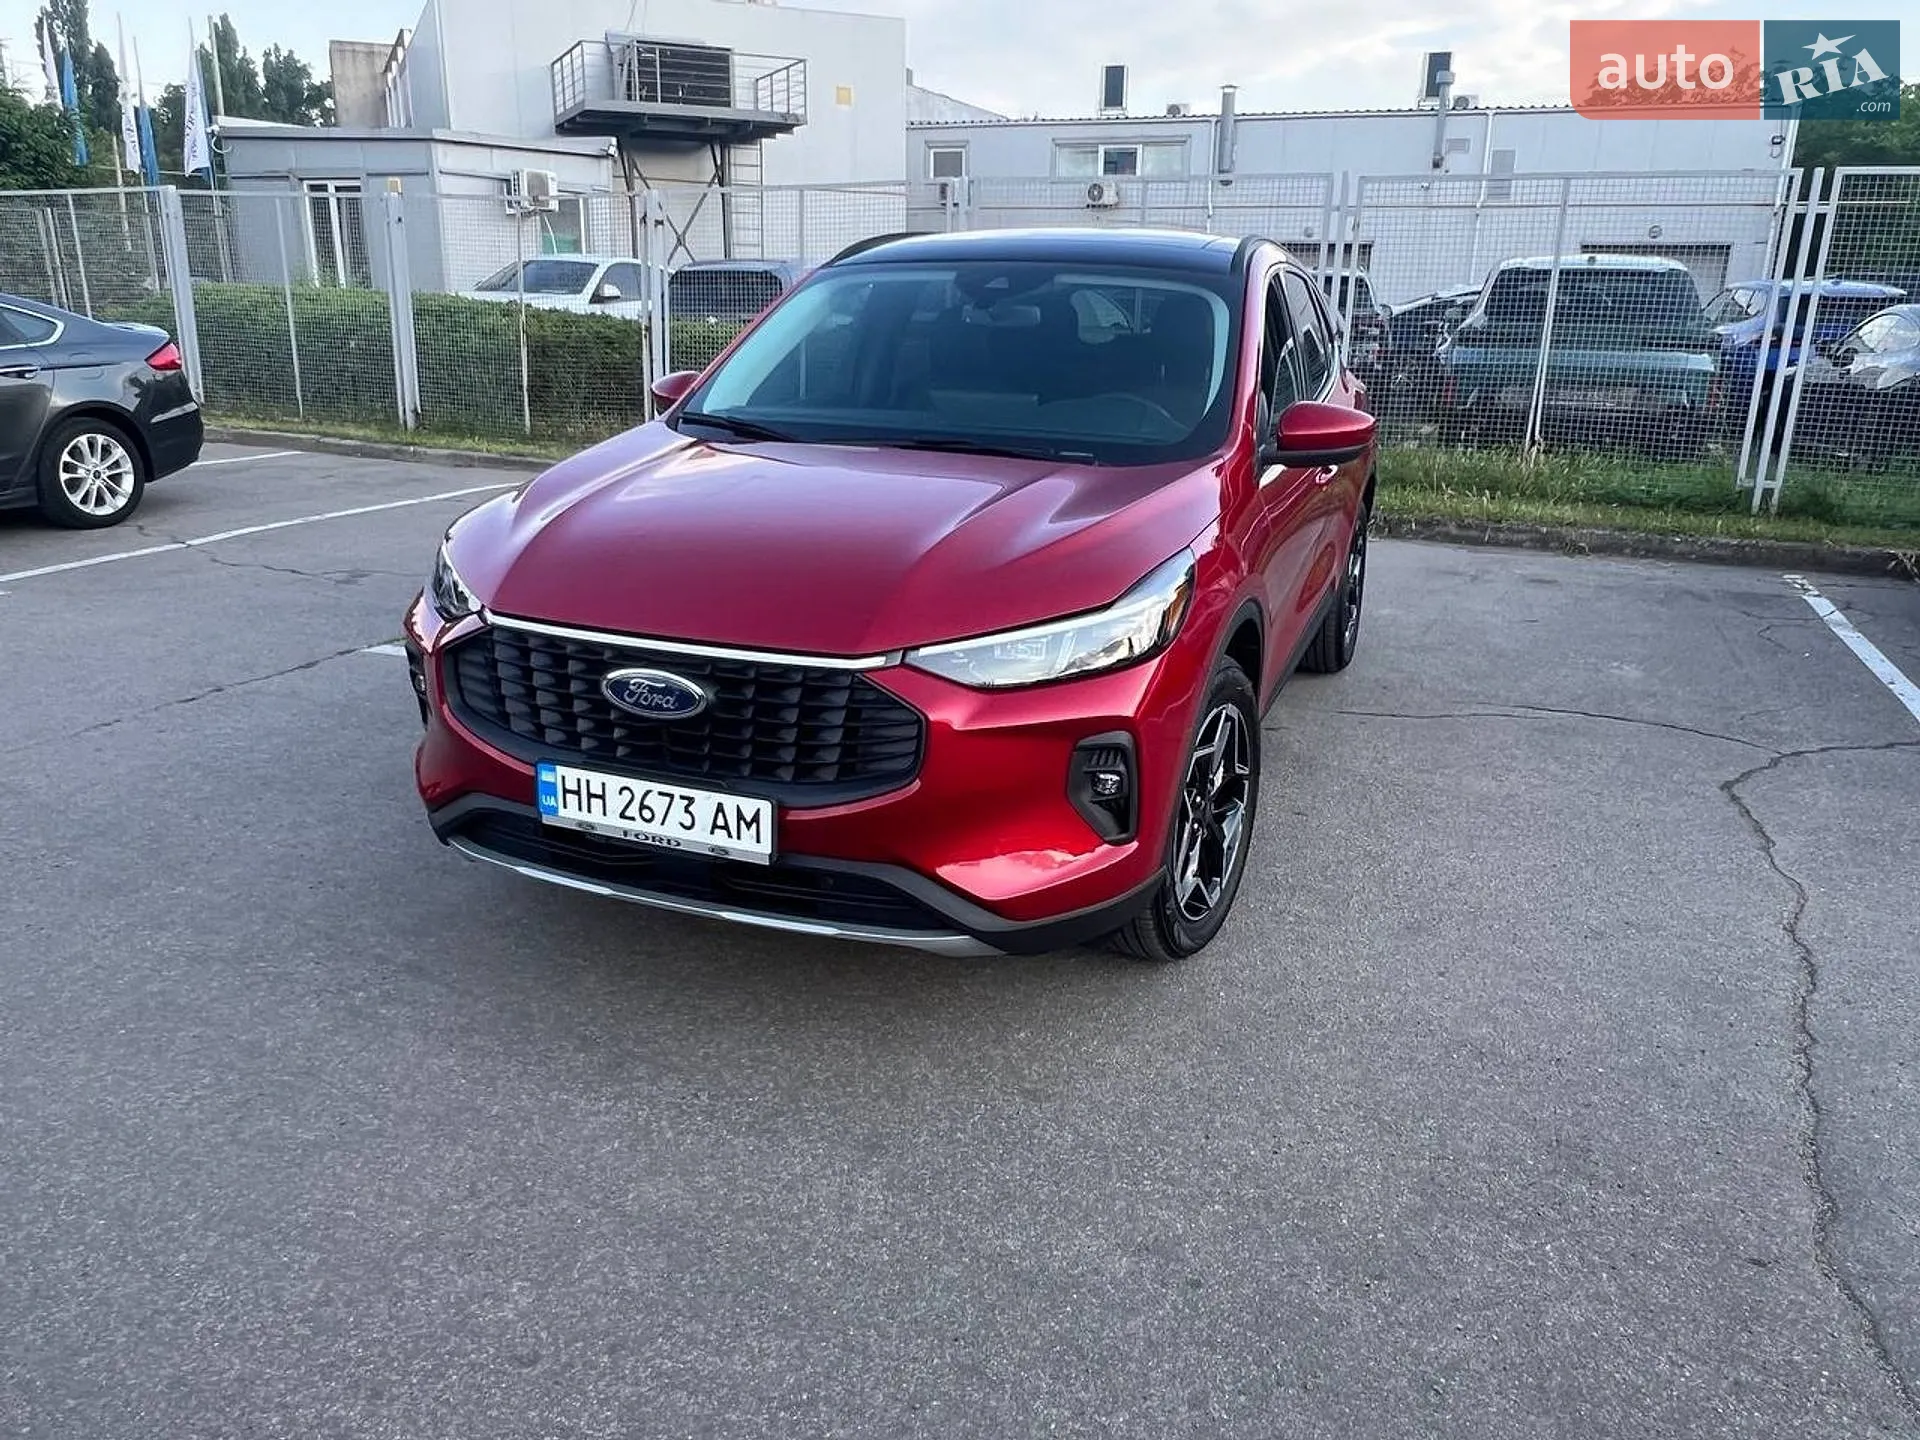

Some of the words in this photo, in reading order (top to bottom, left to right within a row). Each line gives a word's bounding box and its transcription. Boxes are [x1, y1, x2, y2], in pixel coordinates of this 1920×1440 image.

[623, 678, 676, 709] Ford
[542, 795, 557, 807] UA
[561, 775, 607, 817] HH
[618, 785, 696, 831] 2673
[709, 802, 762, 844] AM
